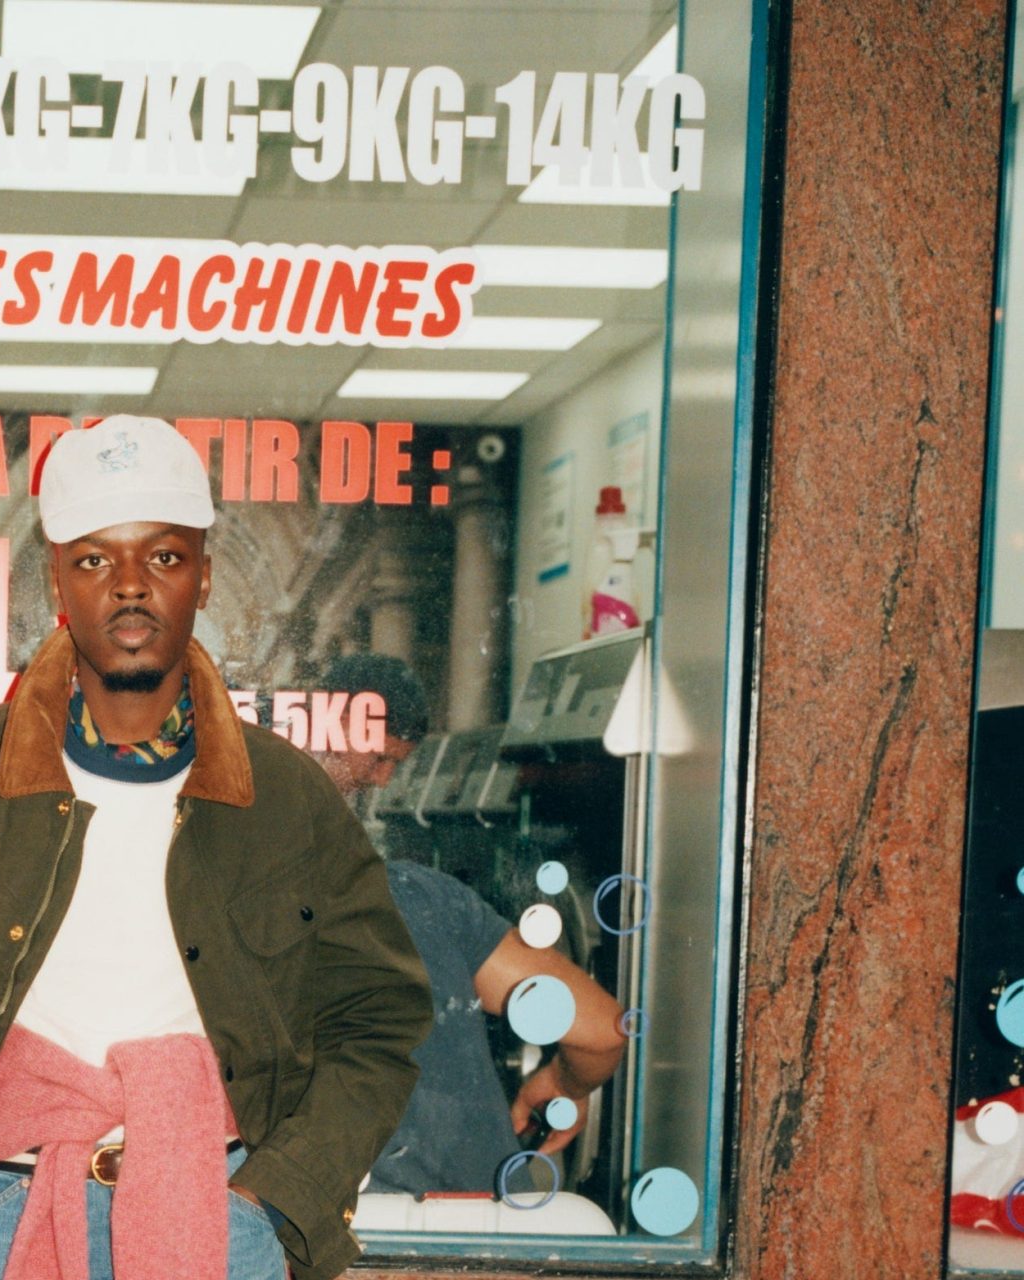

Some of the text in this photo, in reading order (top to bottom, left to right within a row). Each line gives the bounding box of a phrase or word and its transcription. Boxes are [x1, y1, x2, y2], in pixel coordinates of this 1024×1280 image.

[59, 251, 476, 338] MACHINES
[29, 415, 301, 503] PTIR
[319, 420, 413, 504] DE
